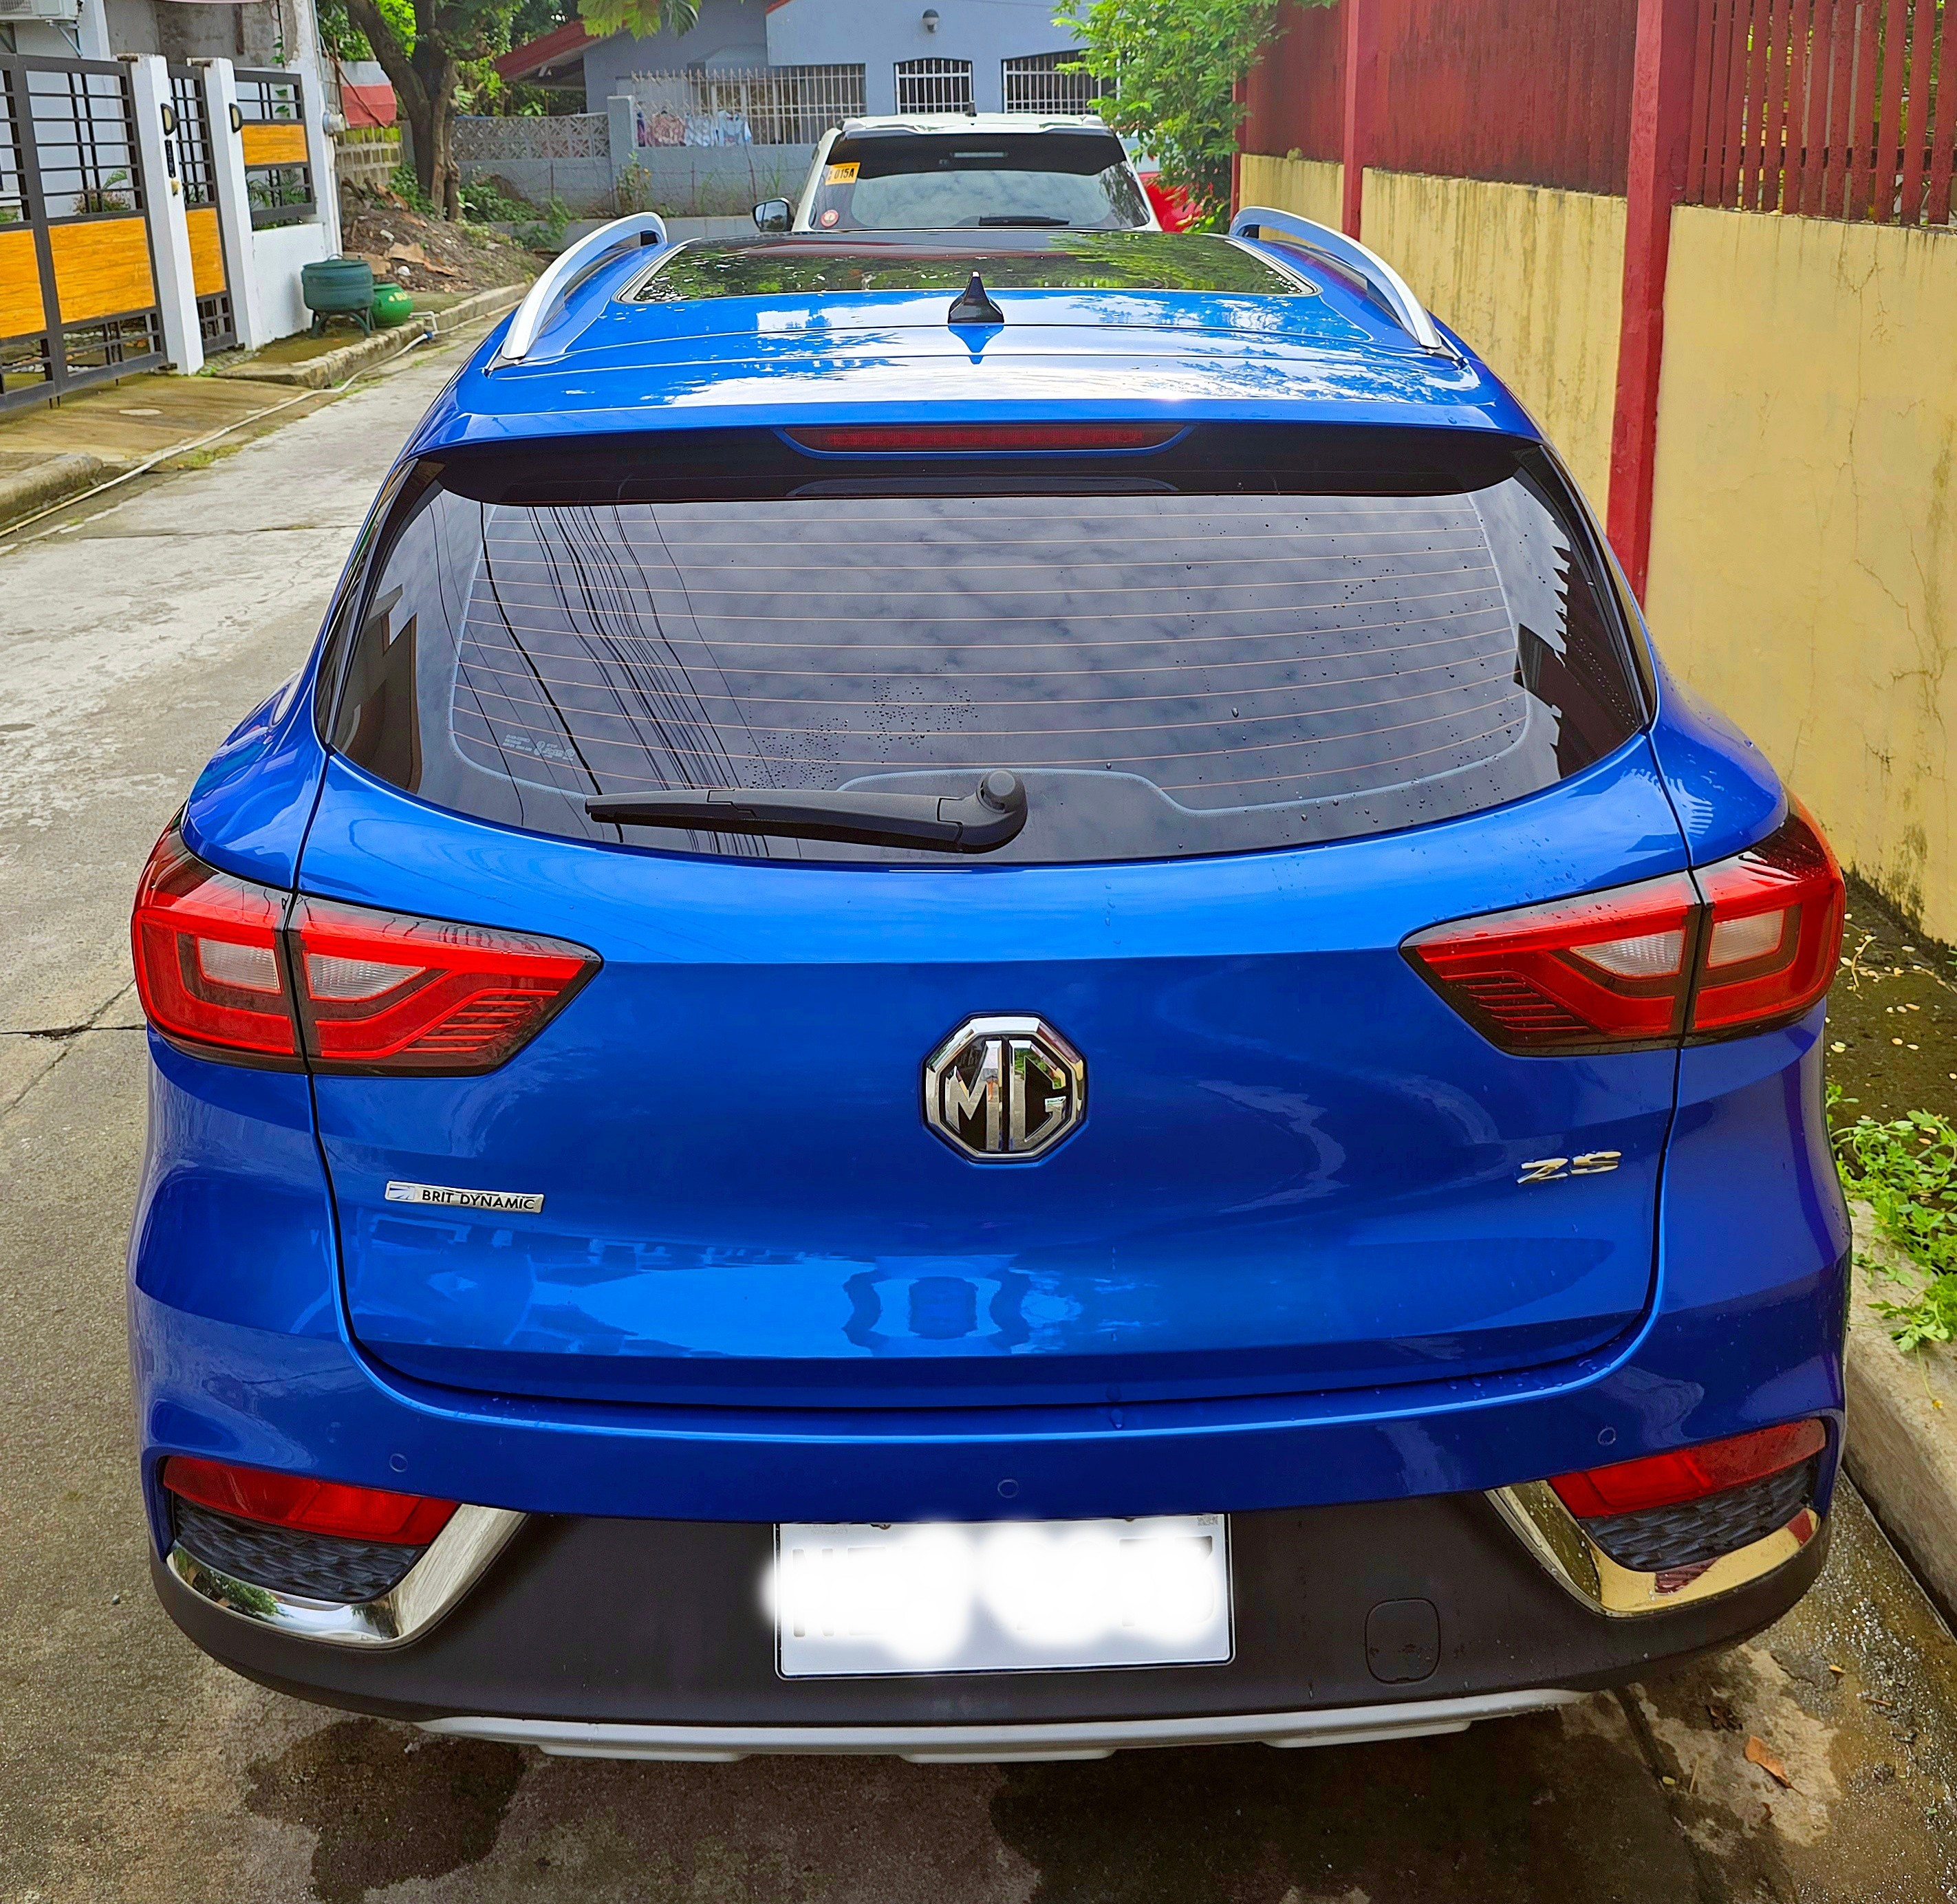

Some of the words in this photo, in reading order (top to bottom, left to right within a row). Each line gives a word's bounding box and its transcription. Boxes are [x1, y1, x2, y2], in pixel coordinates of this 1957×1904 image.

[834, 168, 855, 180] 015A
[945, 1040, 1066, 1151] MG
[1516, 1151, 1622, 1184] ZS
[422, 1189, 454, 1203] BRIT
[459, 1193, 536, 1210] DYNAMIC
